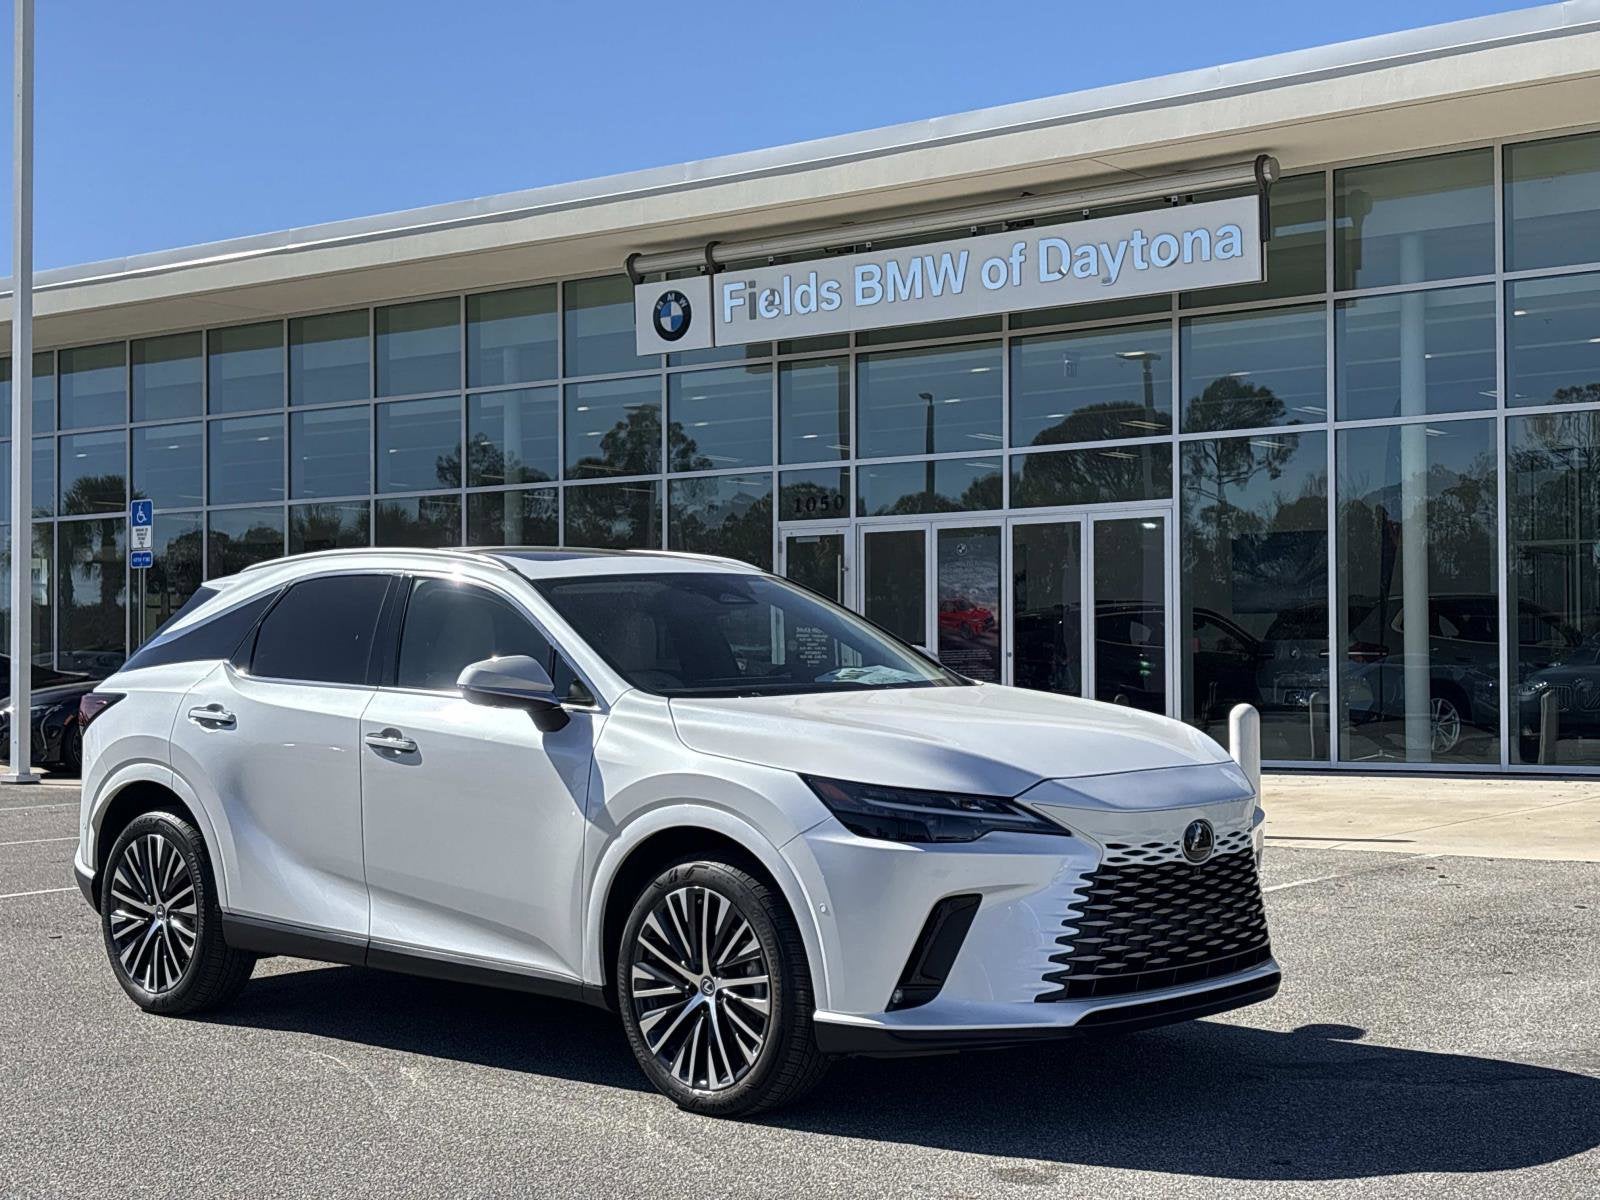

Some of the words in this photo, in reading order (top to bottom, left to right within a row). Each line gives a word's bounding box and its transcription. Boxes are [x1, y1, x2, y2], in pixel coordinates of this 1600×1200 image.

[722, 271, 842, 324] Fields
[854, 251, 969, 307] BMW
[981, 241, 1026, 290] of
[1038, 223, 1244, 287] Daytona
[794, 494, 845, 512] 1050
